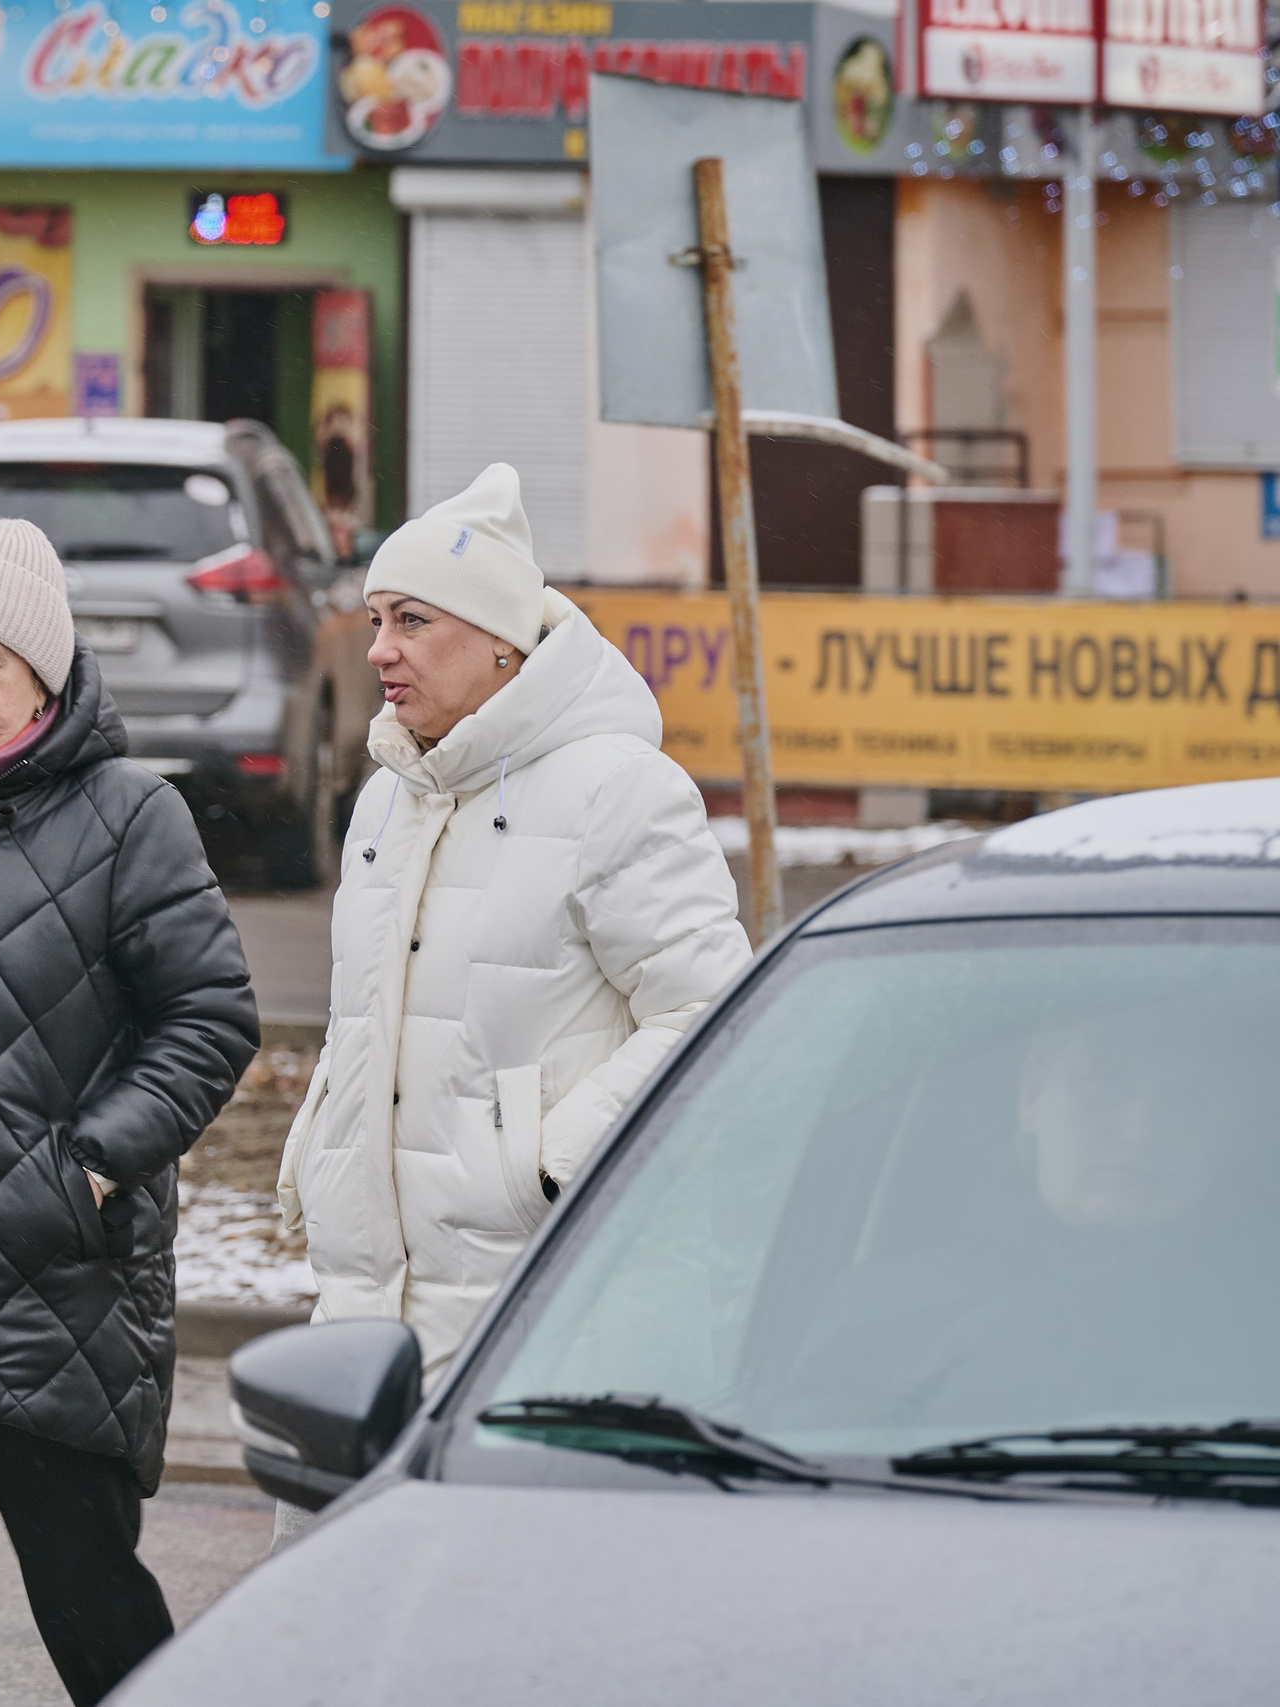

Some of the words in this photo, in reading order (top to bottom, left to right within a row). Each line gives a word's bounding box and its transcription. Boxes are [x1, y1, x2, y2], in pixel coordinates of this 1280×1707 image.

[624, 623, 734, 690] ДРУ
[813, 628, 1013, 698] ЛУЧШЕ
[1028, 634, 1229, 703] НОВЫХ
